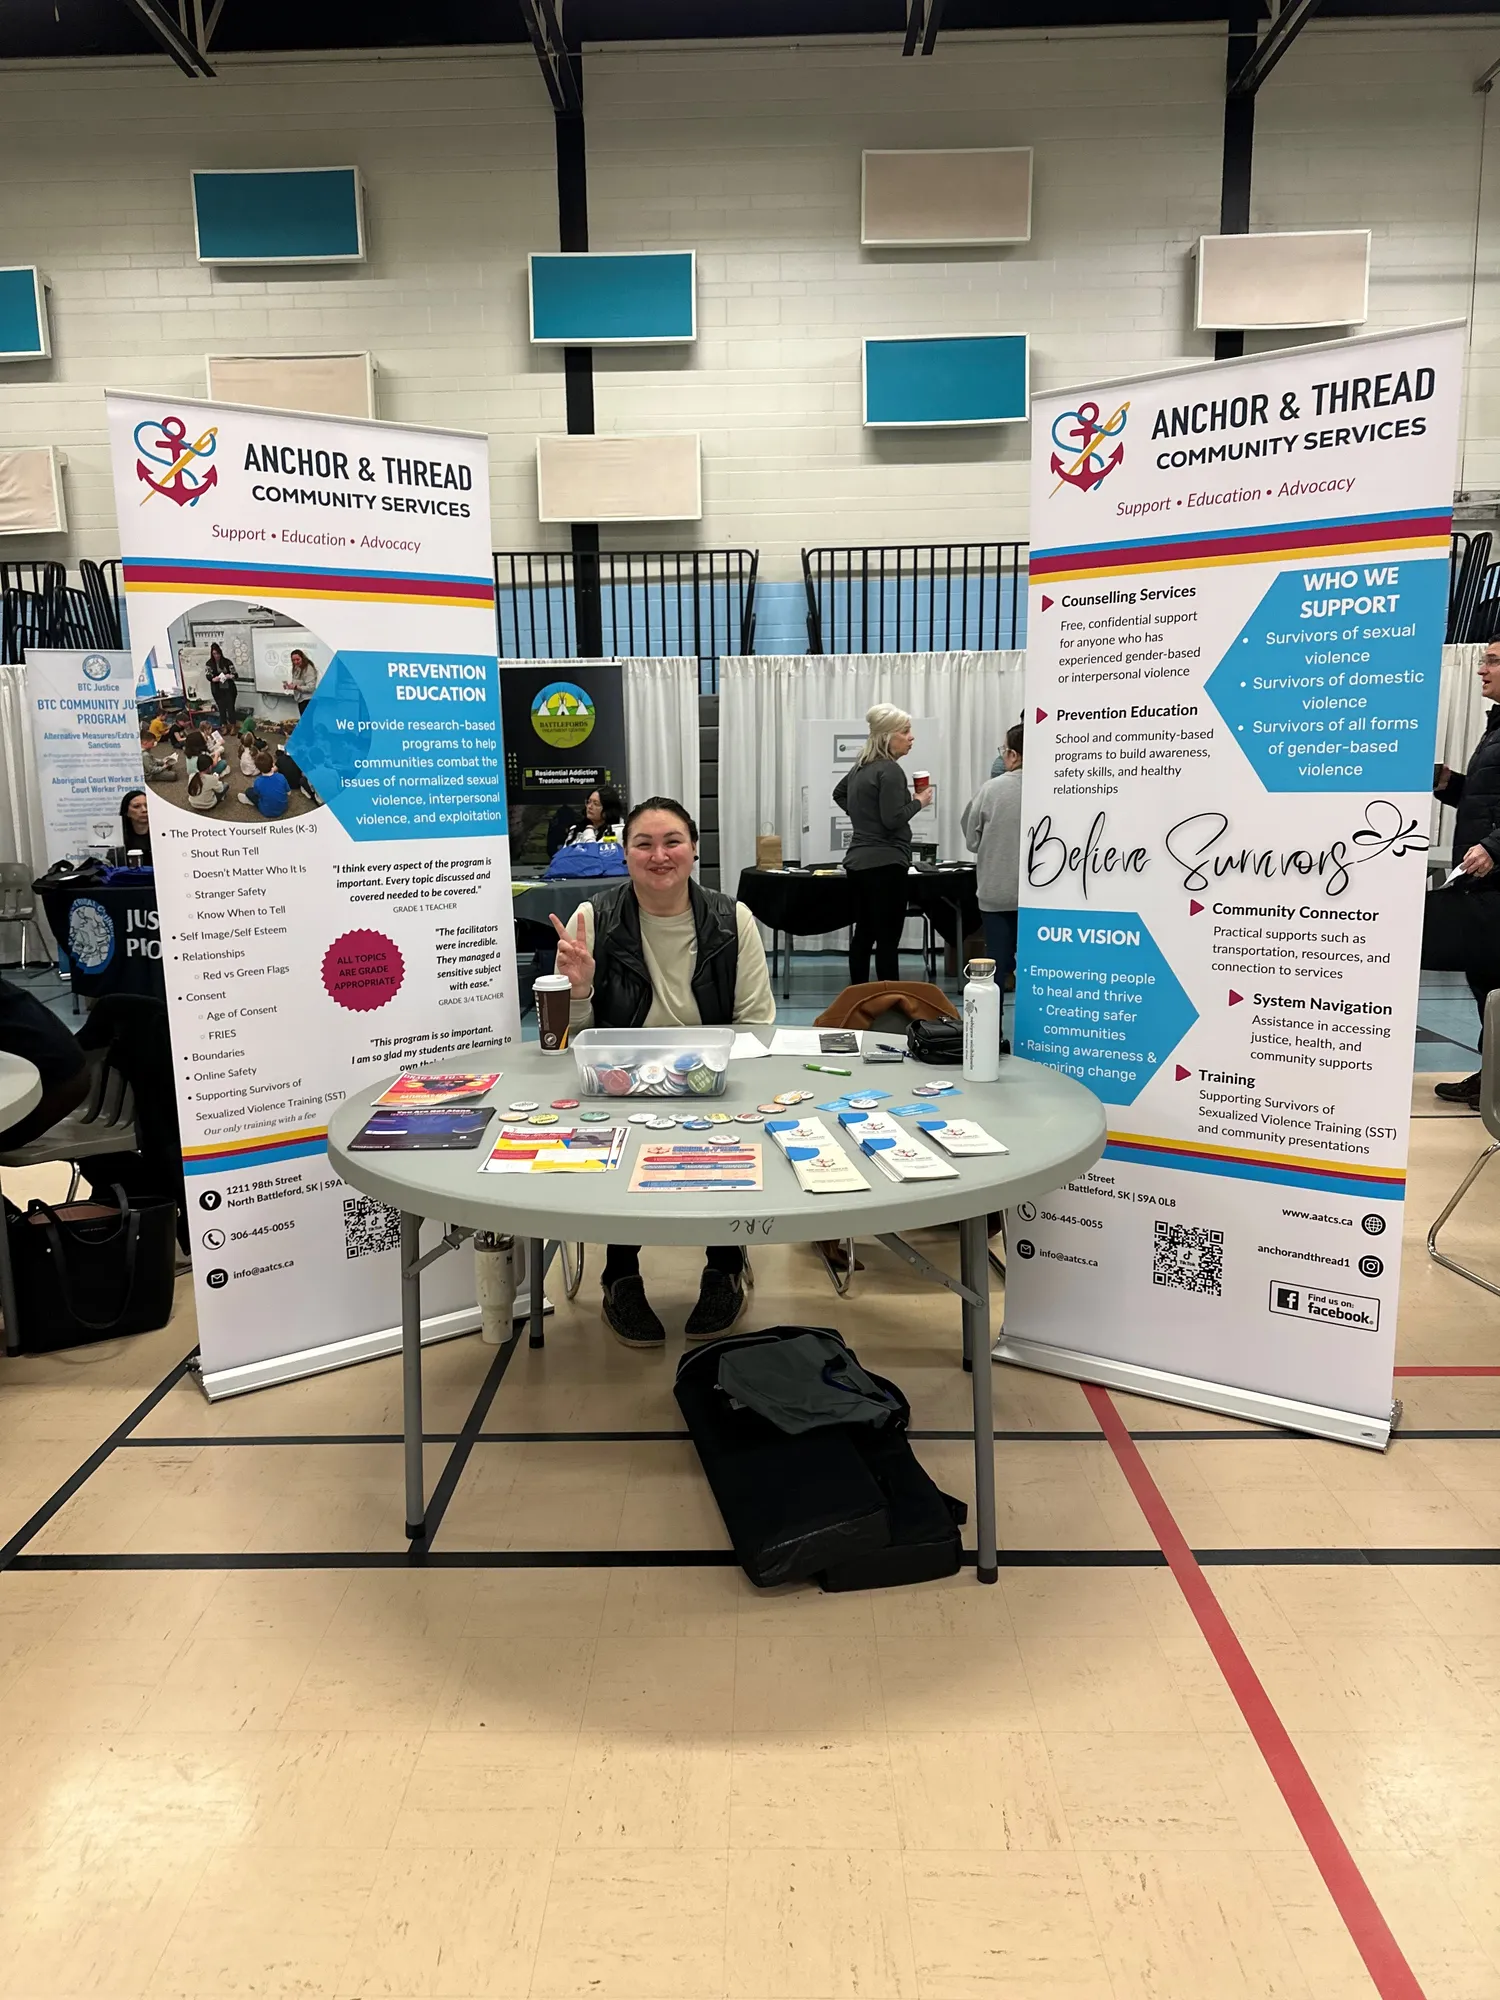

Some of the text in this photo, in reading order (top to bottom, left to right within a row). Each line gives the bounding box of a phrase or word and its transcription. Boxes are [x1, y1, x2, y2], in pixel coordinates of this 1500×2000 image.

[1152, 367, 1436, 440] ANCHOR & THREAD
[1156, 417, 1427, 470] COMMUNITY SERVICES
[244, 443, 473, 492] ANCHOR & THREAD
[252, 485, 471, 519] COMMUNITY SERVICES
[1117, 476, 1355, 517] Support Education Advocacy
[212, 524, 421, 554] Support Education Advocacy
[1303, 567, 1399, 592] WHO WE
[1062, 586, 1196, 608] Counselling Services
[1300, 595, 1400, 619] SUPPORT
[1061, 611, 1198, 631] Free, confidential support
[1266, 624, 1416, 645] Survivors of sexual
[1305, 651, 1370, 665] violence
[388, 662, 487, 680] PREVENTION
[1253, 670, 1425, 690] Survivors of domestic
[78, 683, 120, 692] BTC Justice
[396, 686, 487, 702] EDUCATION
[38, 699, 57, 710] BTC
[60, 699, 120, 710] COMMUNITY
[1302, 697, 1368, 710] violence
[78, 714, 126, 724] PROGRAM
[1057, 704, 1198, 722] Prevention Education
[336, 719, 496, 733] We provide research-based
[82, 732, 135, 740] Measures/Extra
[402, 738, 497, 752] programs to help
[1056, 729, 1214, 744] School and community-based
[354, 756, 498, 769] communities combat the
[88, 776, 107, 784] Court
[341, 774, 499, 788] issues of normalized sexual
[72, 786, 90, 794] Court
[91, 785, 116, 793] Worker
[372, 792, 500, 807] violence, interpersonal
[356, 810, 502, 826] violence, and exploitation
[170, 824, 318, 839] The Protect Yourself Rules (K-3)
[1027, 811, 1361, 900] Believe Survivors
[195, 887, 267, 900] Stranger Safety
[1213, 902, 1380, 922] Community Connector
[1037, 926, 1141, 946] OUR VISION
[182, 950, 246, 962] Relationships
[337, 953, 387, 965] ALL TOPICS
[339, 965, 389, 977] ARE GRADE
[1030, 966, 1156, 986] Empowering people
[334, 977, 396, 991] APPROPRIATE
[186, 991, 227, 1002] Consent
[438, 992, 504, 1007] GRADE 3/4 TEACHER
[1253, 993, 1393, 1016] System Navigation
[192, 1049, 246, 1062] Boundaries
[194, 1067, 258, 1082] Online Safety
[1199, 1069, 1256, 1089] Training
[226, 1174, 302, 1196] 1211 98th Street
[1087, 1172, 1116, 1185] Street
[227, 1196, 255, 1209] North
[257, 1187, 305, 1203] Battleford,
[306, 1182, 319, 1193] SK
[325, 1178, 343, 1190] S9A
[1068, 1182, 1117, 1200] Battleford,
[1117, 1190, 1131, 1201] SK
[1137, 1192, 1157, 1206] S9A
[1040, 1210, 1104, 1230] 306-445-0055
[1282, 1208, 1354, 1228] www.aatcs.ca
[230, 1220, 296, 1242] 306-445-0055
[1039, 1248, 1099, 1269] info@aatcs.ca
[1258, 1244, 1351, 1269] anchorandthread1
[233, 1259, 295, 1280] info@aatcs.ca
[1308, 1294, 1355, 1309] Find us on:
